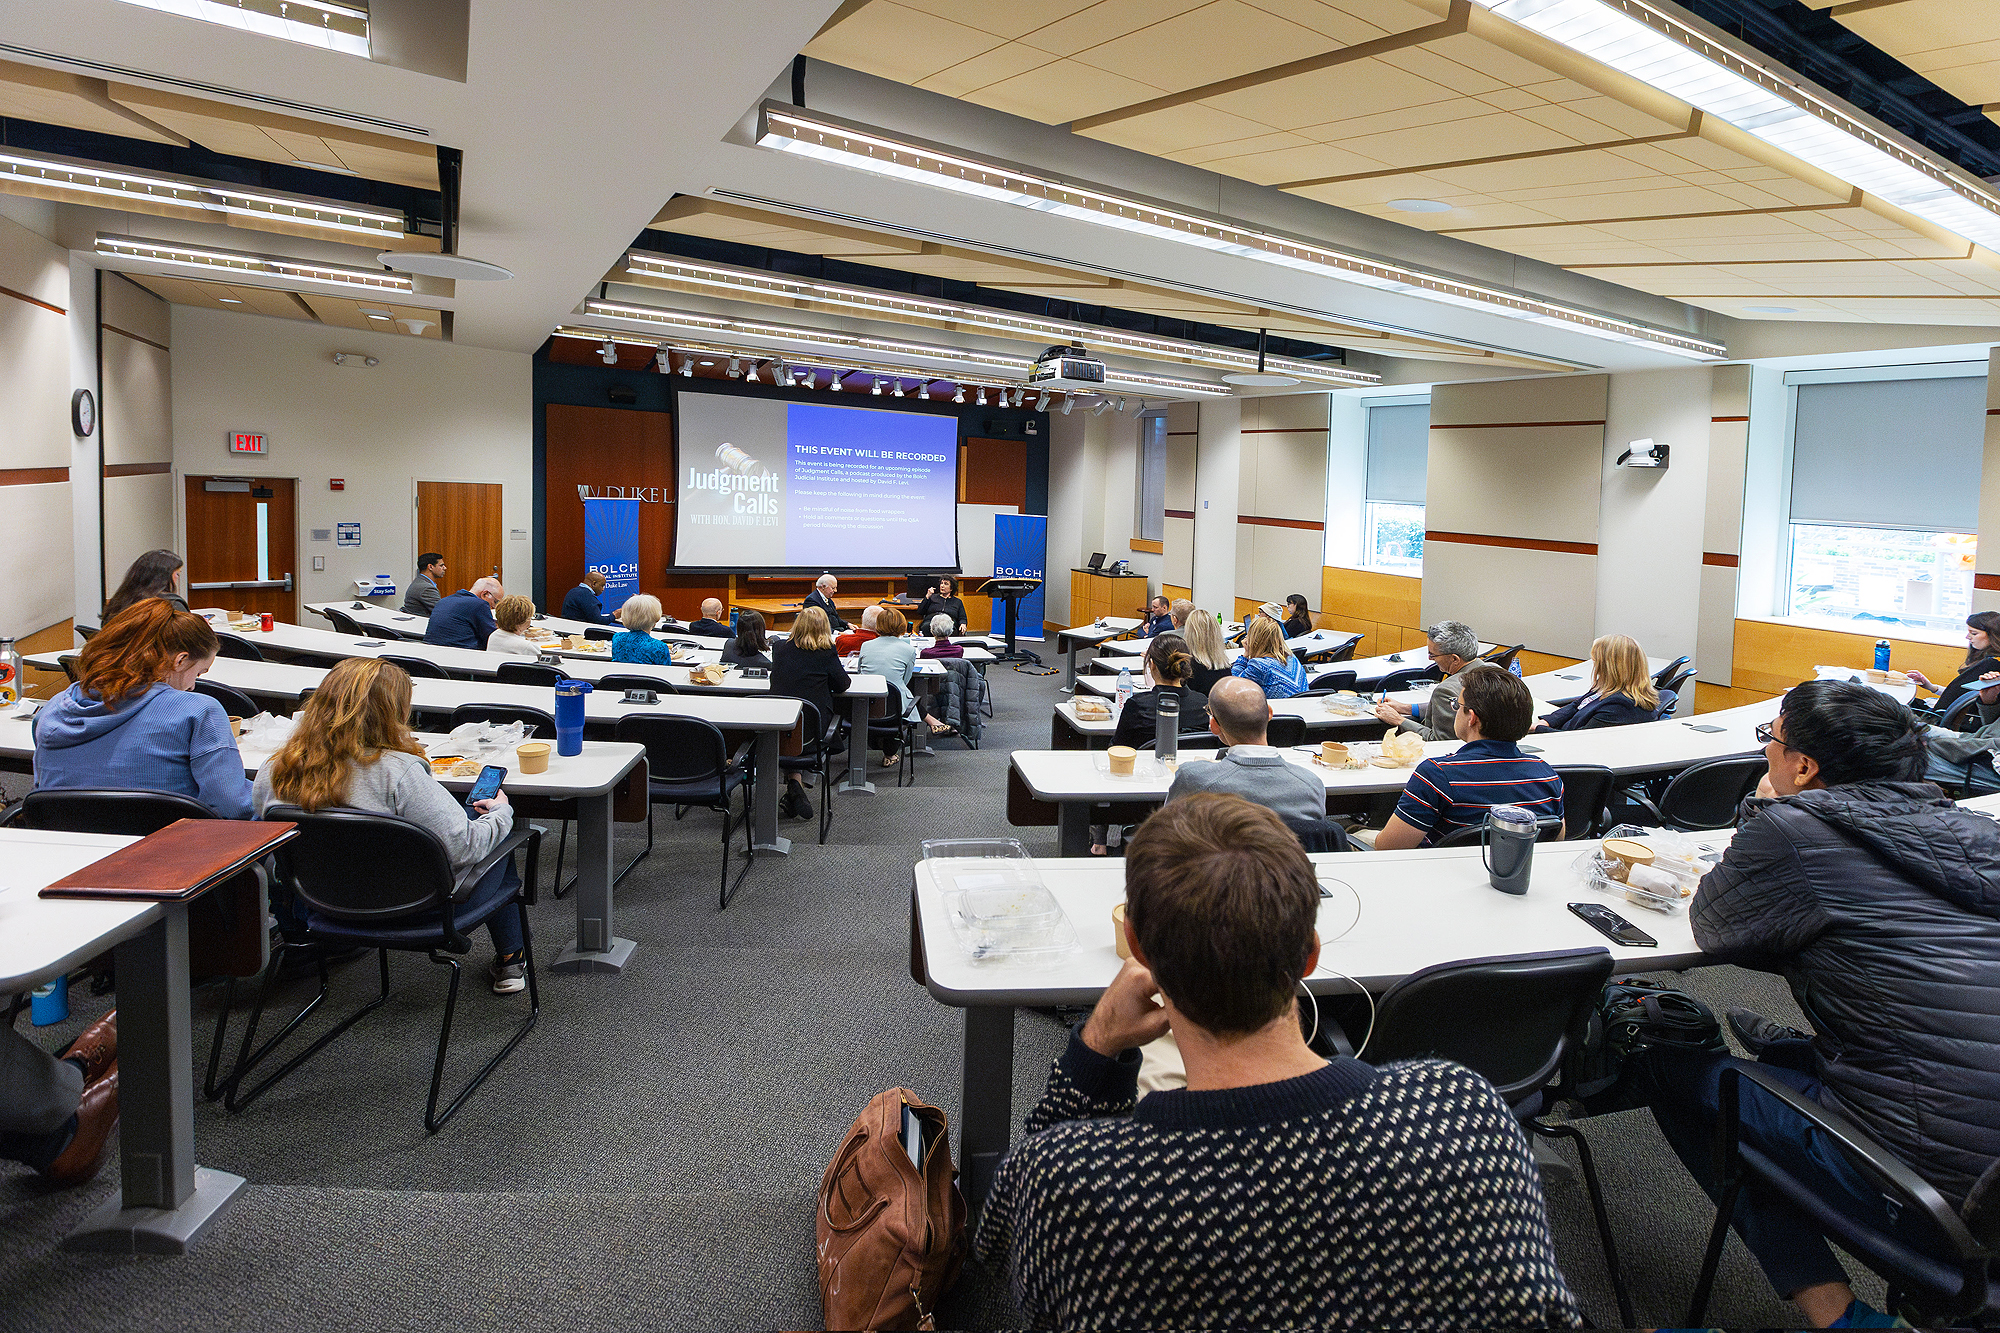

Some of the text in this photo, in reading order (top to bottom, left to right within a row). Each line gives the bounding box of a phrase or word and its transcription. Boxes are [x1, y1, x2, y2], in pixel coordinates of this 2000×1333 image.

[236, 434, 263, 451] EXIT
[795, 445, 818, 454] THIS
[820, 447, 852, 456] EVENT
[855, 449, 879, 458] WILL
[896, 452, 946, 462] RECORDED
[687, 468, 779, 495] Judgment
[606, 486, 659, 502] DUKE
[734, 492, 778, 515] Calls
[690, 514, 778, 526] WITH HON. DAVID F. LEVI
[996, 566, 1041, 577] BOLCH
